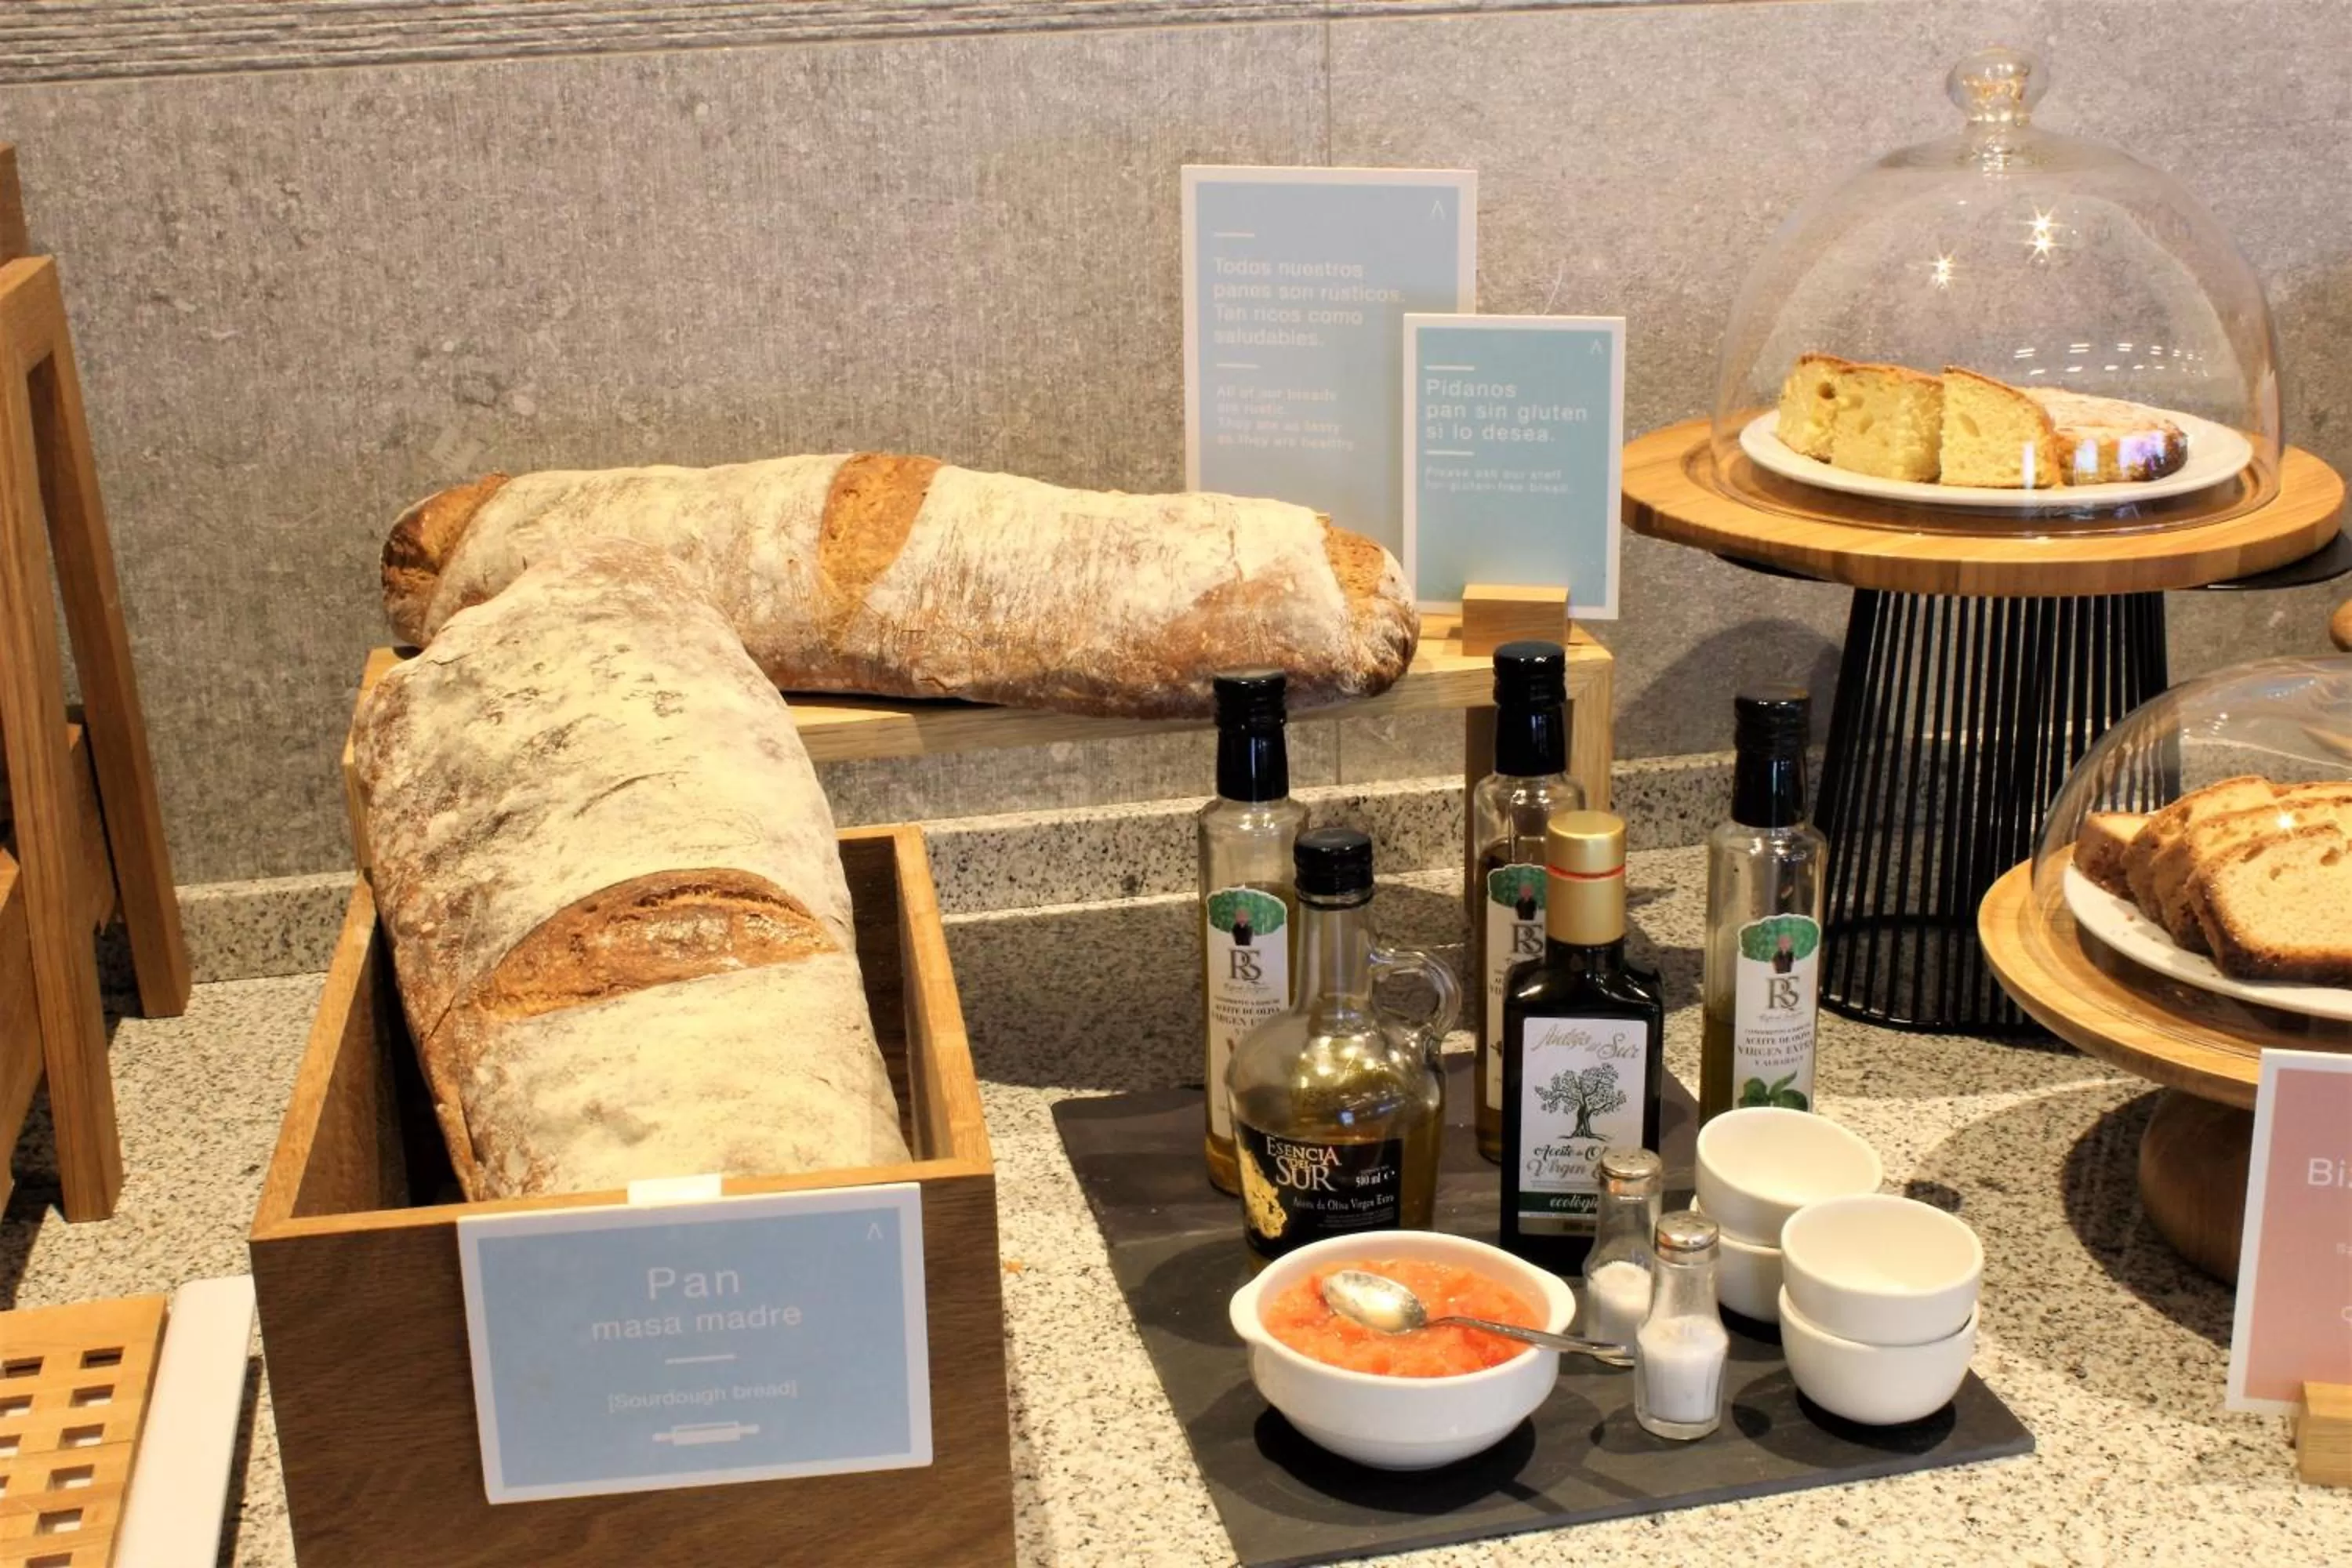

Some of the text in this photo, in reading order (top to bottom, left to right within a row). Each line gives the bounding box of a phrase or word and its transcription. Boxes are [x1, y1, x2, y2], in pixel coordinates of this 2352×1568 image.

[1214, 256, 1270, 276] Todos
[1279, 285, 1313, 302] son
[1214, 303, 1248, 322] Tan
[1308, 310, 1363, 325] como
[1425, 403, 1588, 424] pan sin gluten
[1425, 422, 1556, 443] si lo desea.
[1228, 947, 1262, 985] RS
[1766, 975, 1801, 1011] RS
[1596, 1031, 1640, 1061] Sur
[1266, 1135, 1342, 1167] ESENCIA
[1288, 1158, 1311, 1170] DEL
[1275, 1156, 1338, 1193] SUR
[647, 1265, 740, 1301] Pan
[592, 1303, 804, 1342] masa madre
